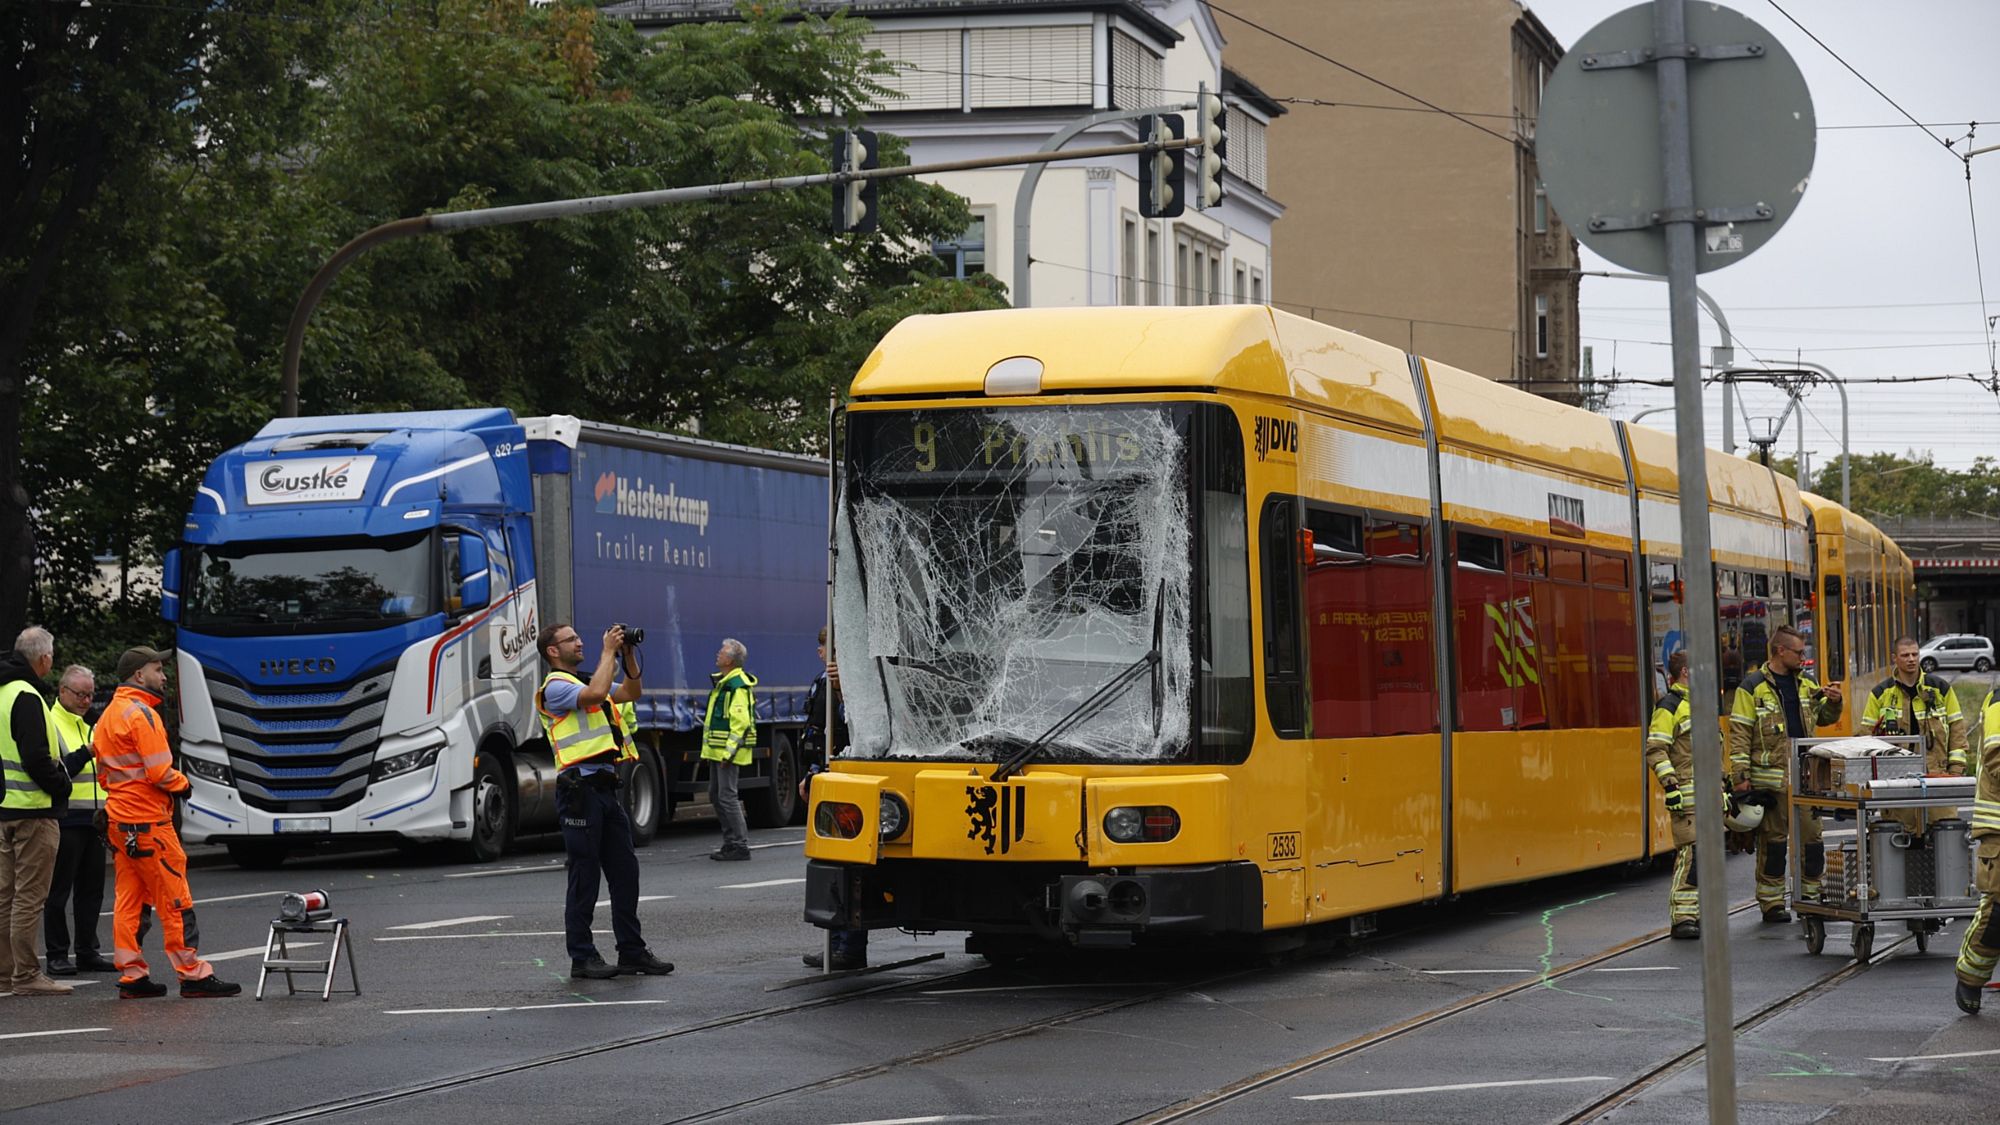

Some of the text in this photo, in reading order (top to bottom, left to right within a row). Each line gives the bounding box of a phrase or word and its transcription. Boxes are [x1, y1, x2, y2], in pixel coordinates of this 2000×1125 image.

[495, 442, 511, 457] 629
[914, 419, 1141, 472] 9 Prohlis
[1271, 417, 1298, 453] DVB
[616, 477, 709, 536] Heisterkamp
[596, 531, 711, 568] Trailer Rental
[260, 657, 336, 674] IVECO
[1272, 835, 1296, 857] 2533
